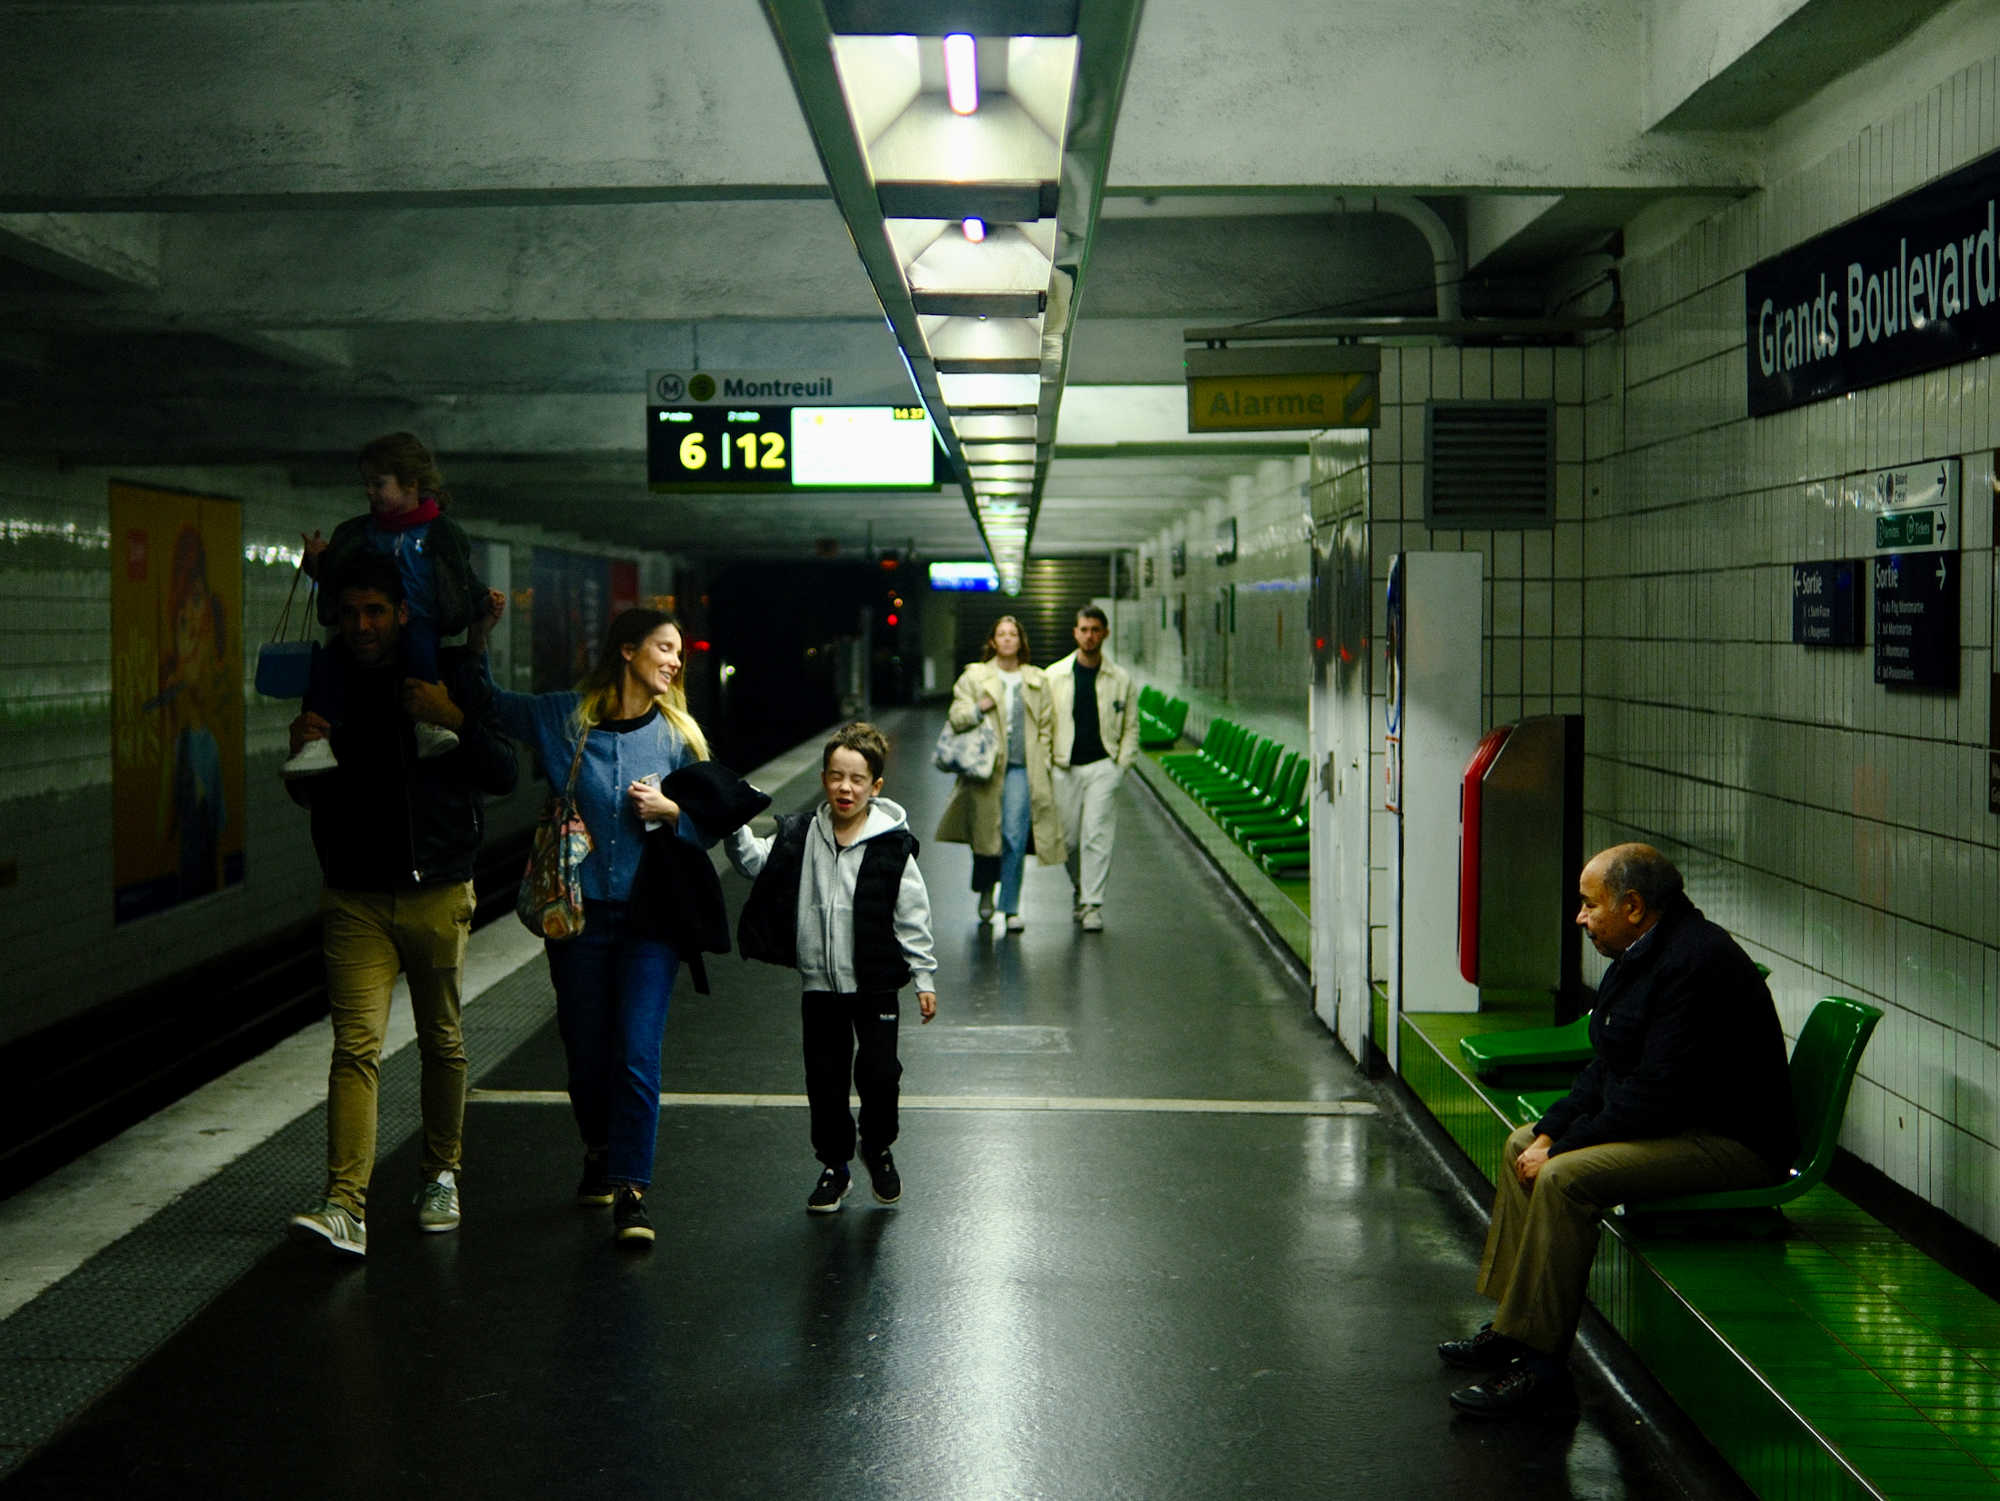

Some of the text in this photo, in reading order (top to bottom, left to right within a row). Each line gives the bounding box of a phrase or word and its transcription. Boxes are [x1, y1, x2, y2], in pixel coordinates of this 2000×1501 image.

[1759, 199, 2000, 377] Grands Boulevard
[723, 377, 832, 398] Montreuil
[1209, 389, 1325, 417] Alarme
[679, 432, 707, 470] 6
[736, 432, 786, 470] 12
[1802, 572, 1823, 595] Sortie
[1876, 561, 1899, 589] Sortie
